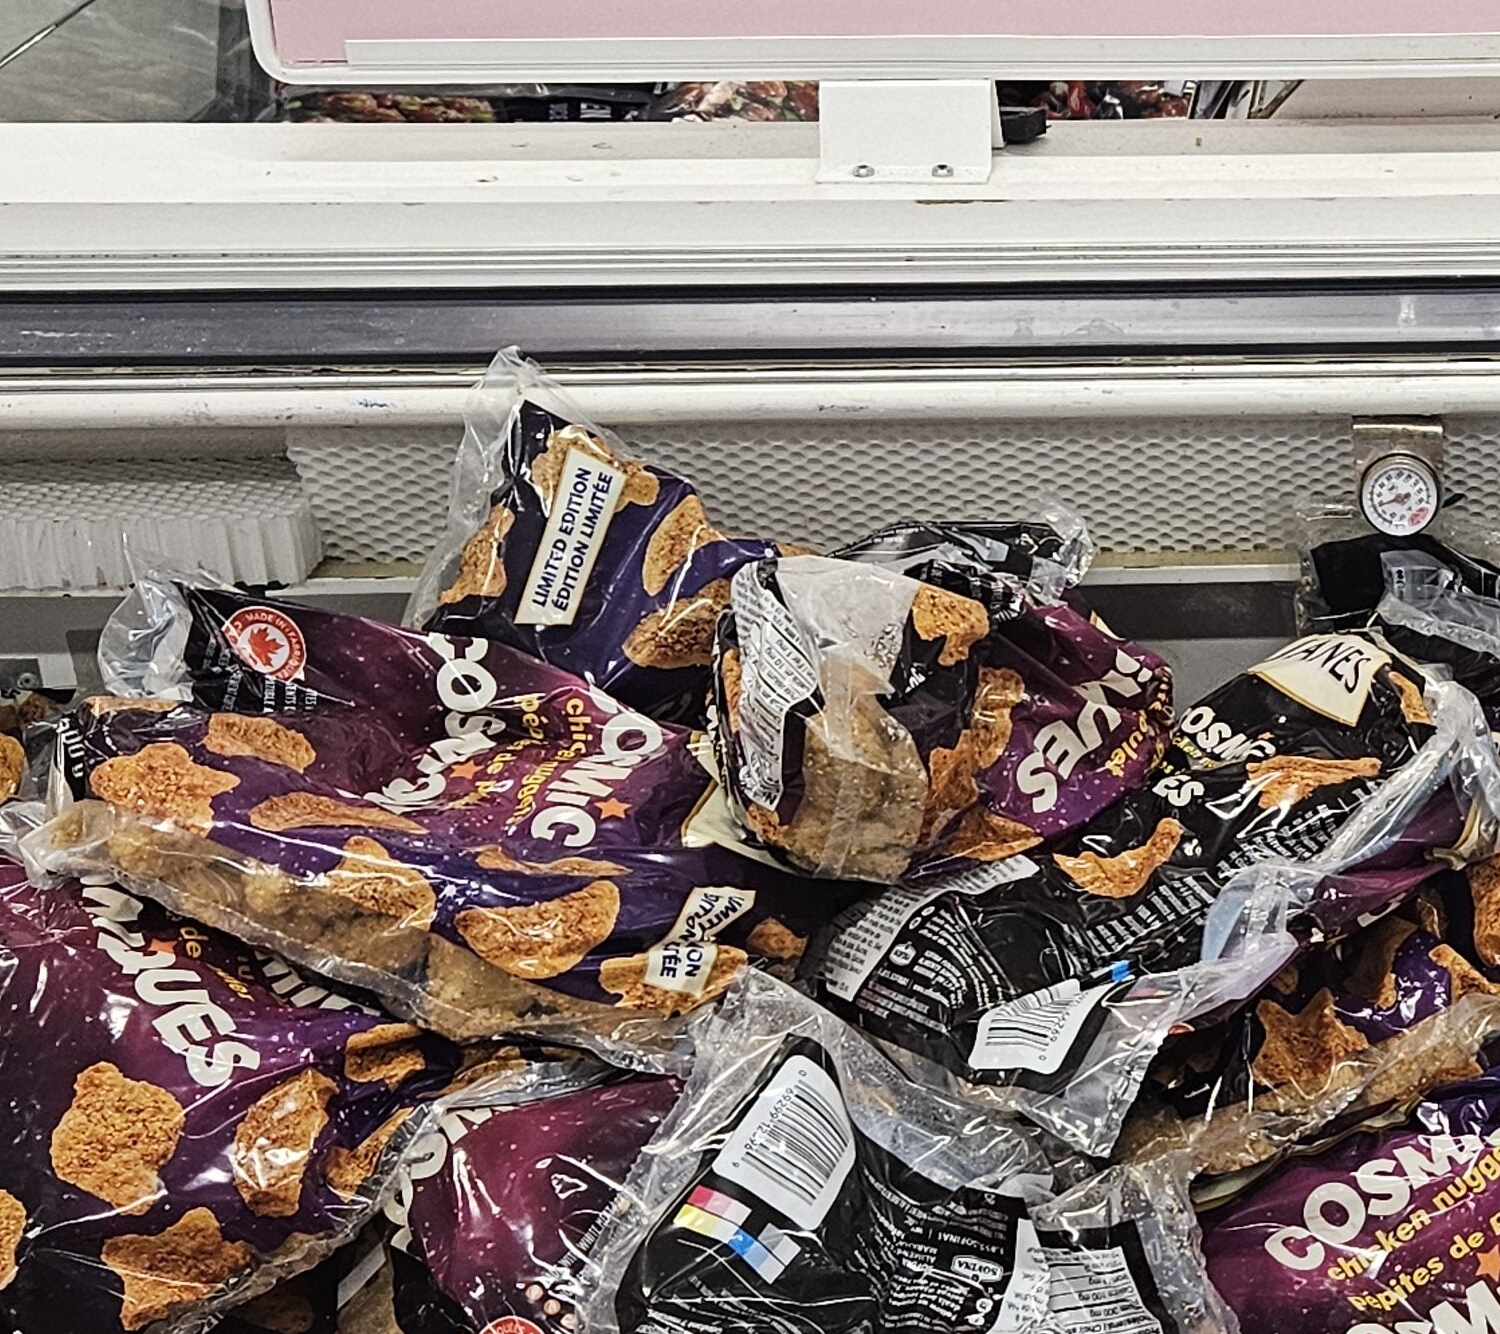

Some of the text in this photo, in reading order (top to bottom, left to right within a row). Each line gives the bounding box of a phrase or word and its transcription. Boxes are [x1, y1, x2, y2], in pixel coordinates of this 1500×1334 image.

[558, 468, 591, 536] EDITION
[580, 472, 613, 538] LIMITÉE
[1449, 1230, 1485, 1261] de
